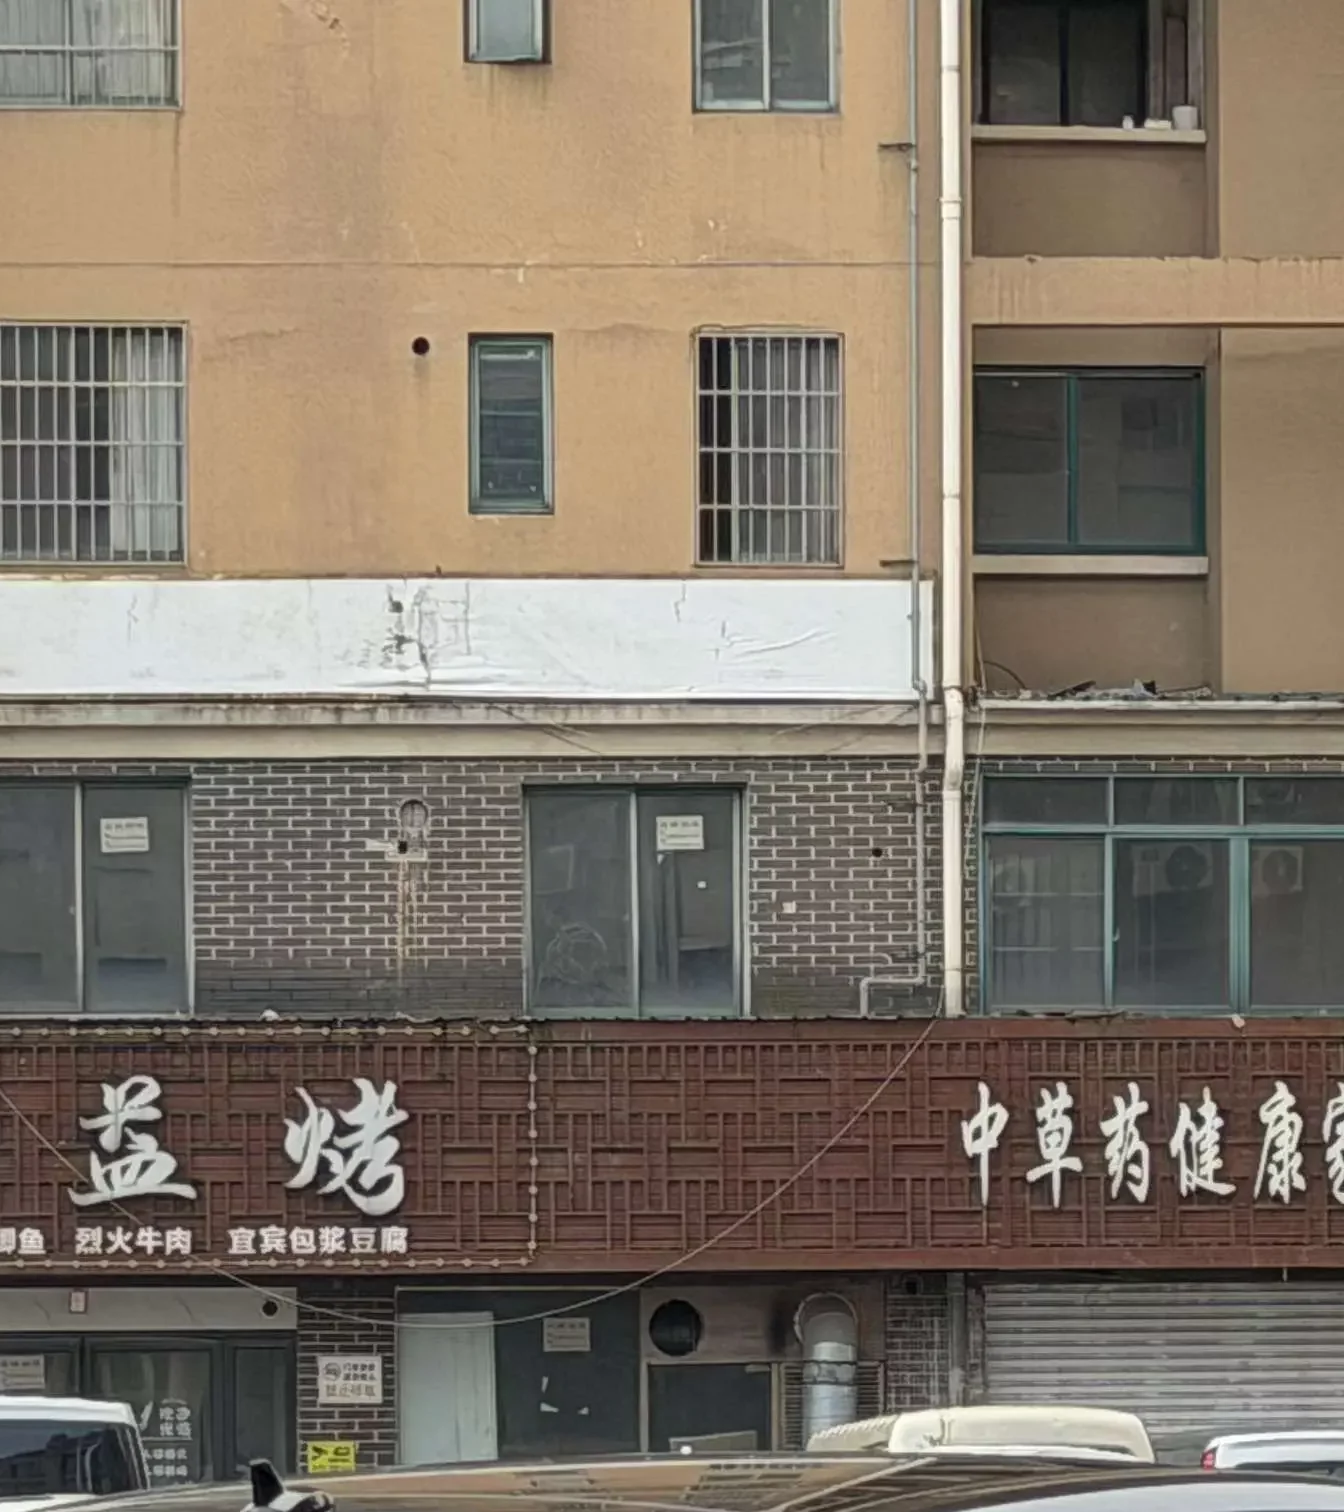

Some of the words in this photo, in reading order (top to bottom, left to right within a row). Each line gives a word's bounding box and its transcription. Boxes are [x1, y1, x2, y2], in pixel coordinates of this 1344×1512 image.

[75, 1226, 192, 1255] 烈火牛肉
[227, 1225, 409, 1255] 宜宾包浆豆腐
